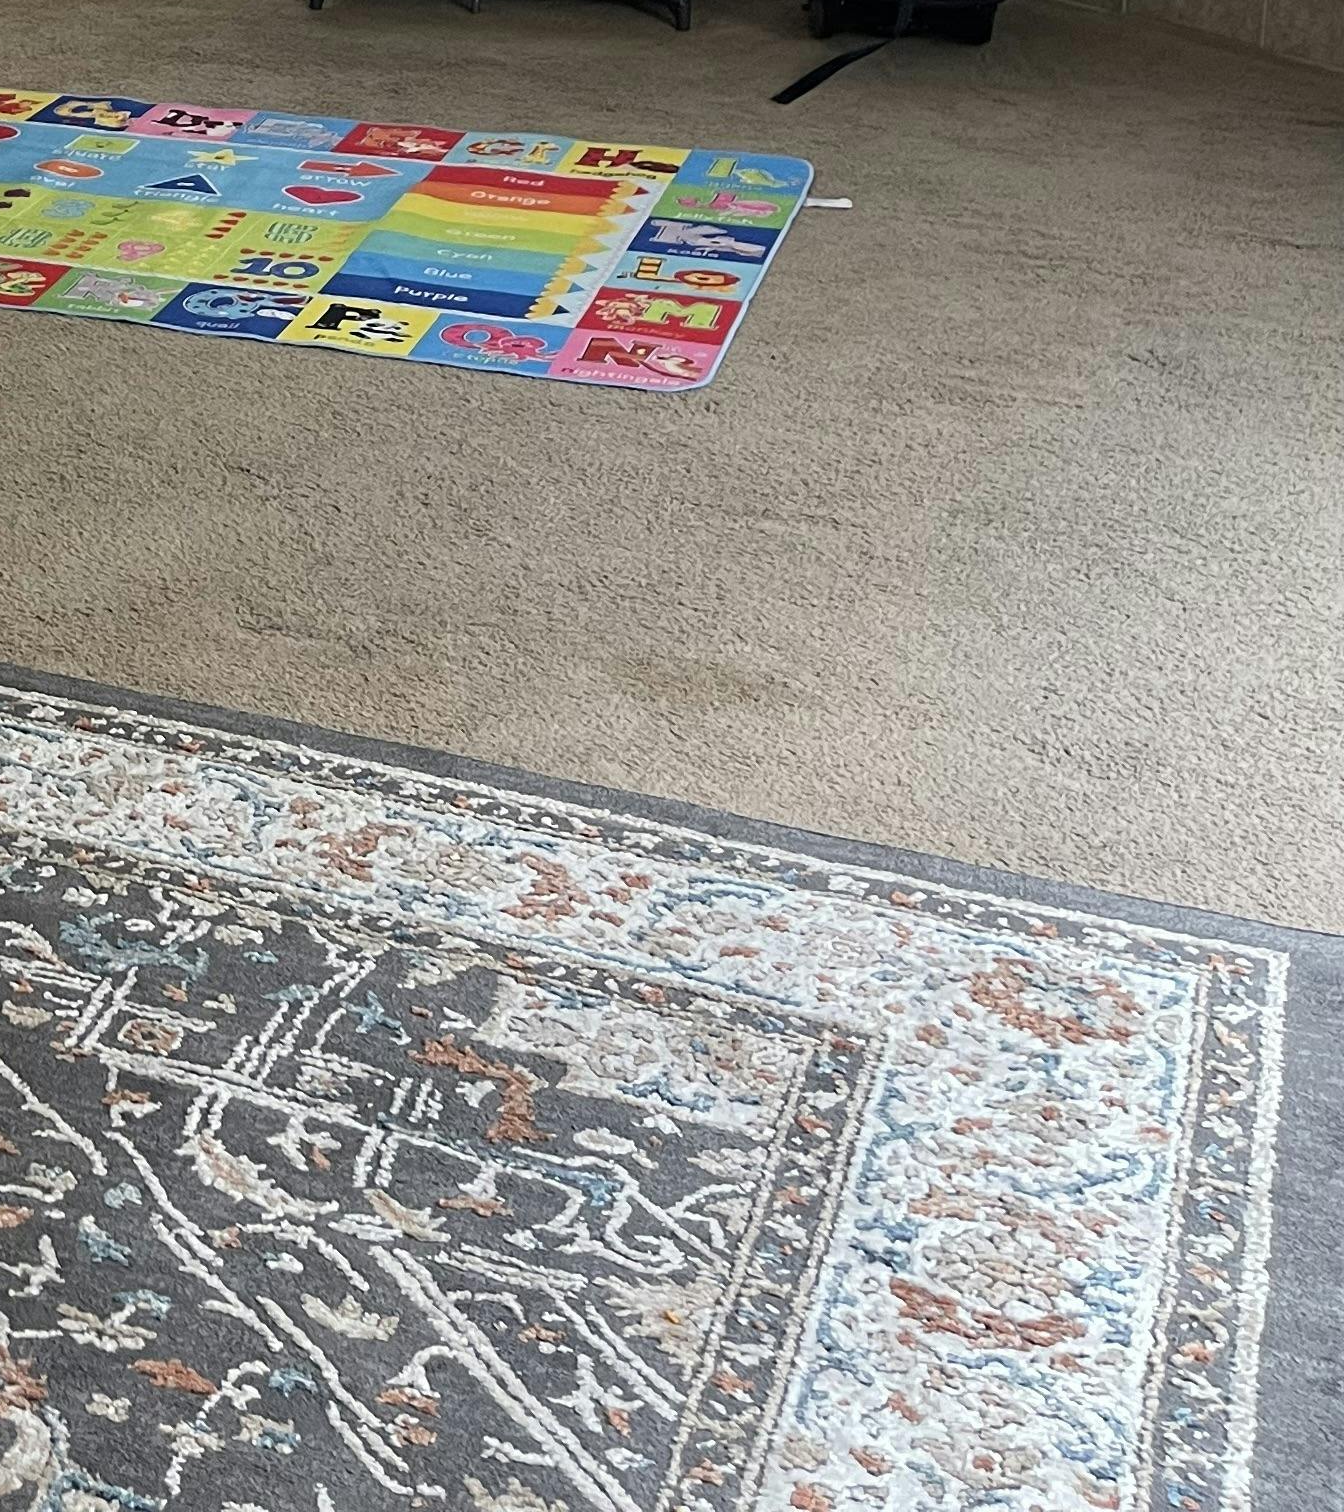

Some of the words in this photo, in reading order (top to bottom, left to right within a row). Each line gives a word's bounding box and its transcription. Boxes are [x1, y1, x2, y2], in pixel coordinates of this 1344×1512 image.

[574, 146, 643, 168] H
[299, 174, 373, 187] arrow
[503, 175, 545, 187] Red
[471, 190, 551, 206] Orange
[229, 256, 321, 280] 10
[423, 266, 474, 280] Blue
[394, 285, 469, 303] Purple
[641, 298, 724, 331] M
[576, 336, 663, 368] N
